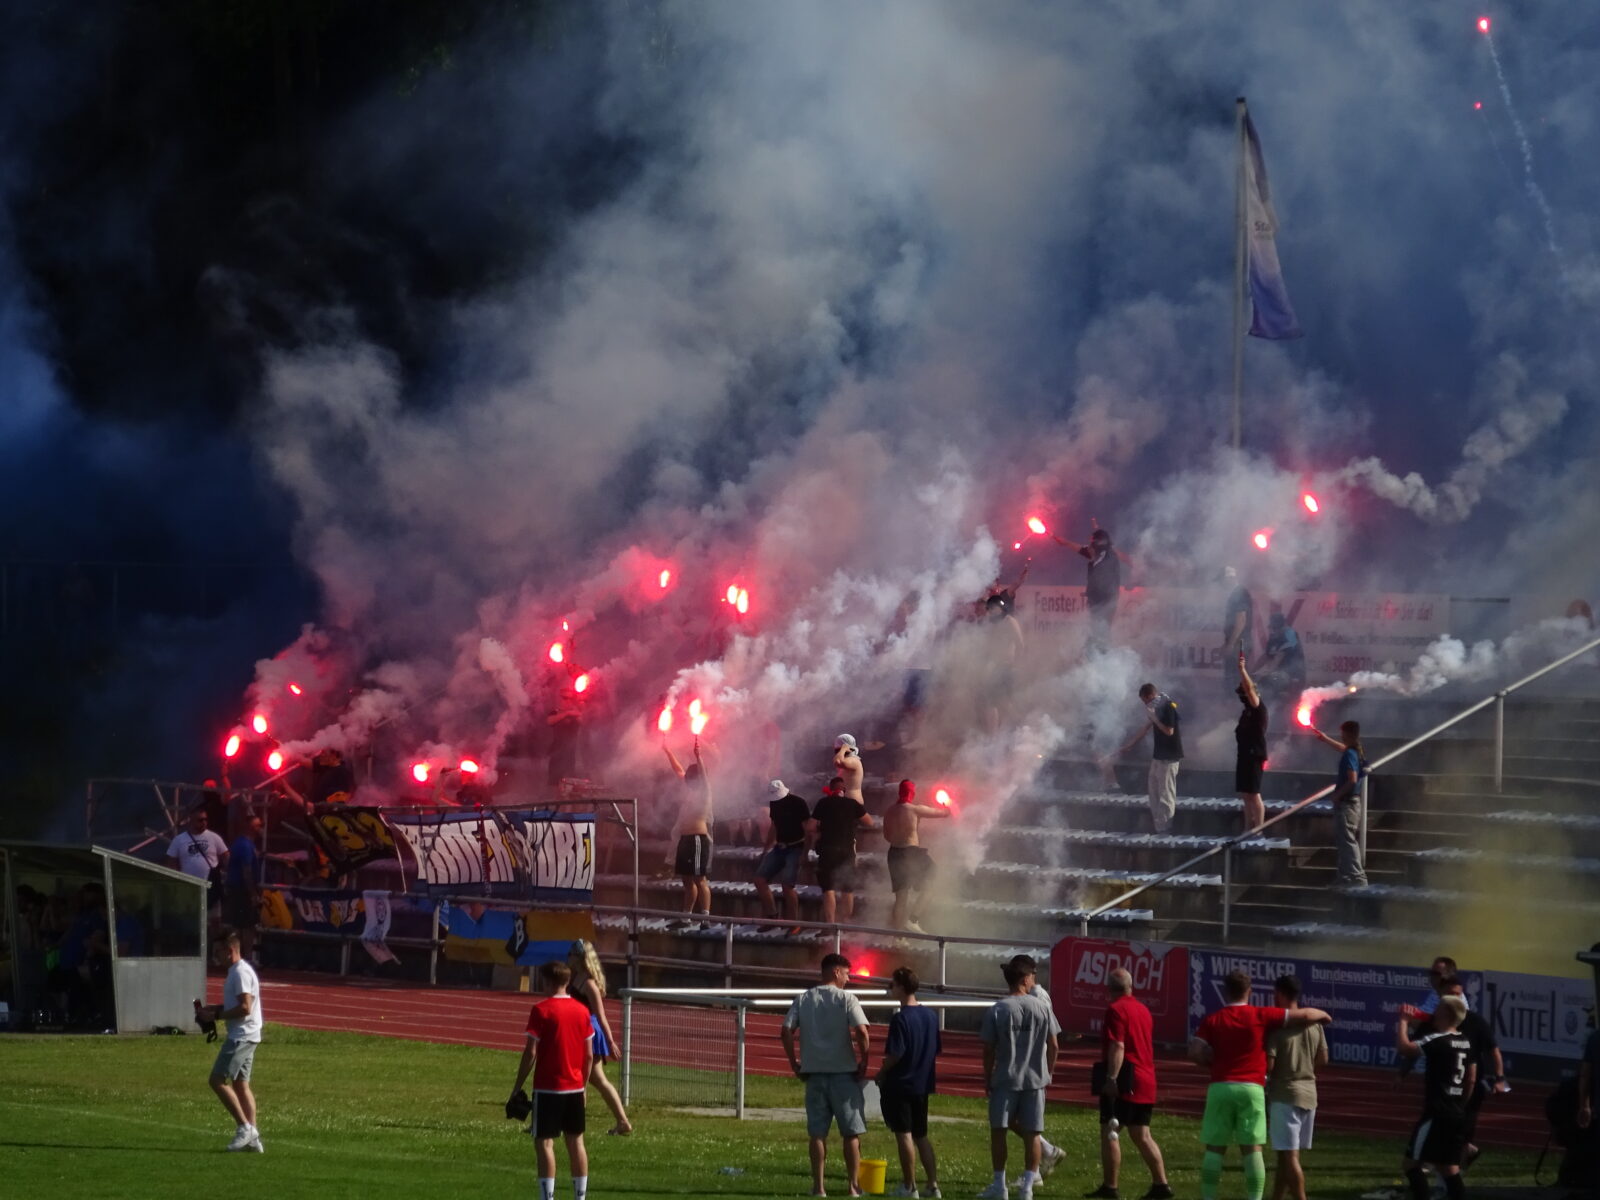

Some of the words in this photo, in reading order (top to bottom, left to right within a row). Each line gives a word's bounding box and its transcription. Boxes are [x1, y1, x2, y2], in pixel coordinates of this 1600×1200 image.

[1311, 964, 1385, 985] bundesweite
[1332, 1042, 1371, 1063] 0800
[1454, 1052, 1467, 1085] 5
